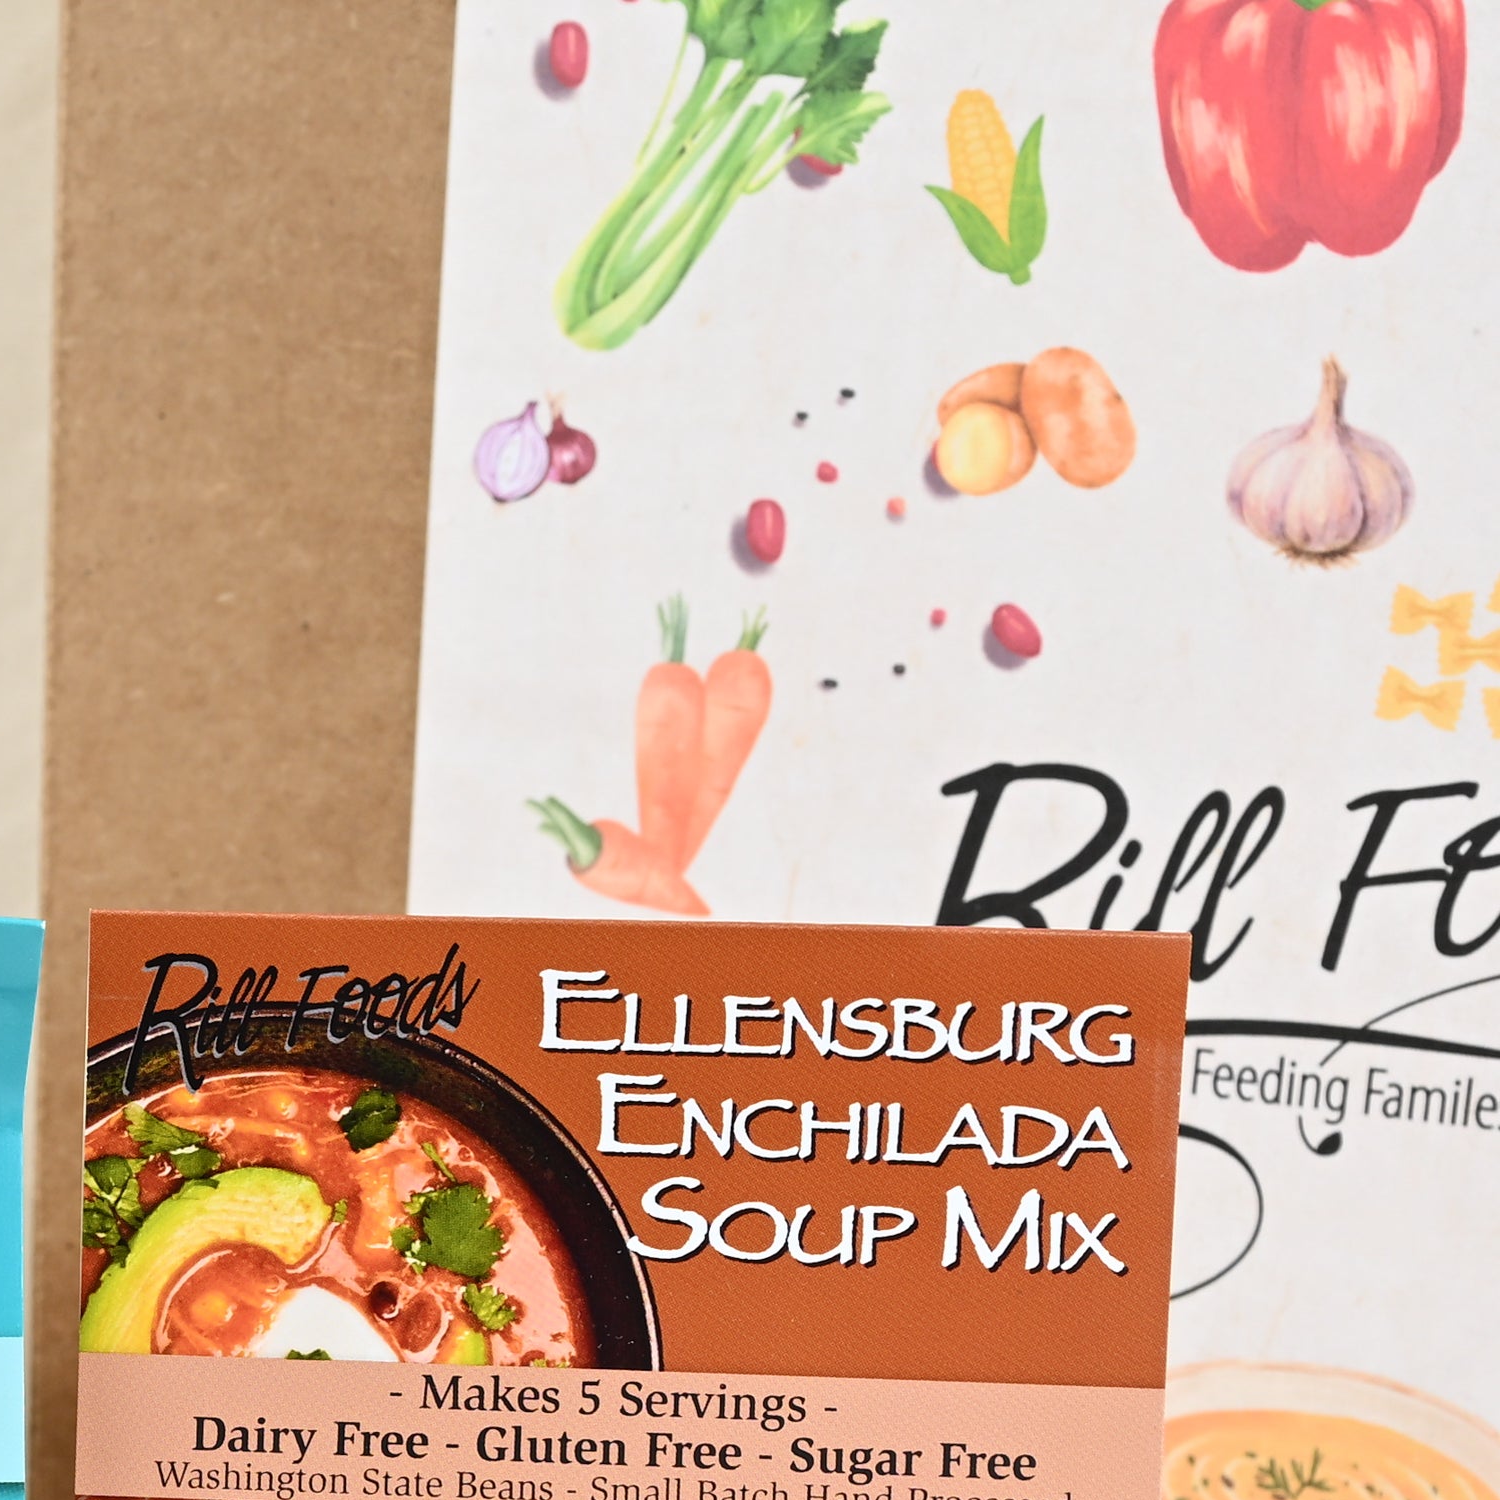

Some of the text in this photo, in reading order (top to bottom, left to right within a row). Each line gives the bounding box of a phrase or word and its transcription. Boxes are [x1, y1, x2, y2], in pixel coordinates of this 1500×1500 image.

[935, 762, 1285, 981] Rill
[122, 942, 480, 1096] Rill Foods
[538, 968, 1136, 1067] ELLENSBURG
[596, 1072, 1132, 1172] ENCHILADA
[1191, 1048, 1500, 1131] Feeding Famile
[626, 1176, 1129, 1275] SOUP MIX
[192, 1415, 318, 1465] Dairy
[334, 1420, 430, 1460] Free
[476, 1425, 628, 1467] Gluten
[647, 1432, 743, 1471] Free
[789, 1436, 923, 1486] Sugar
[940, 1442, 1039, 1482] Free
[420, 1374, 561, 1413] Makes
[578, 1379, 602, 1416] 5
[619, 1379, 808, 1432] Servings
[155, 1459, 349, 1500] Washington
[362, 1468, 444, 1499] State
